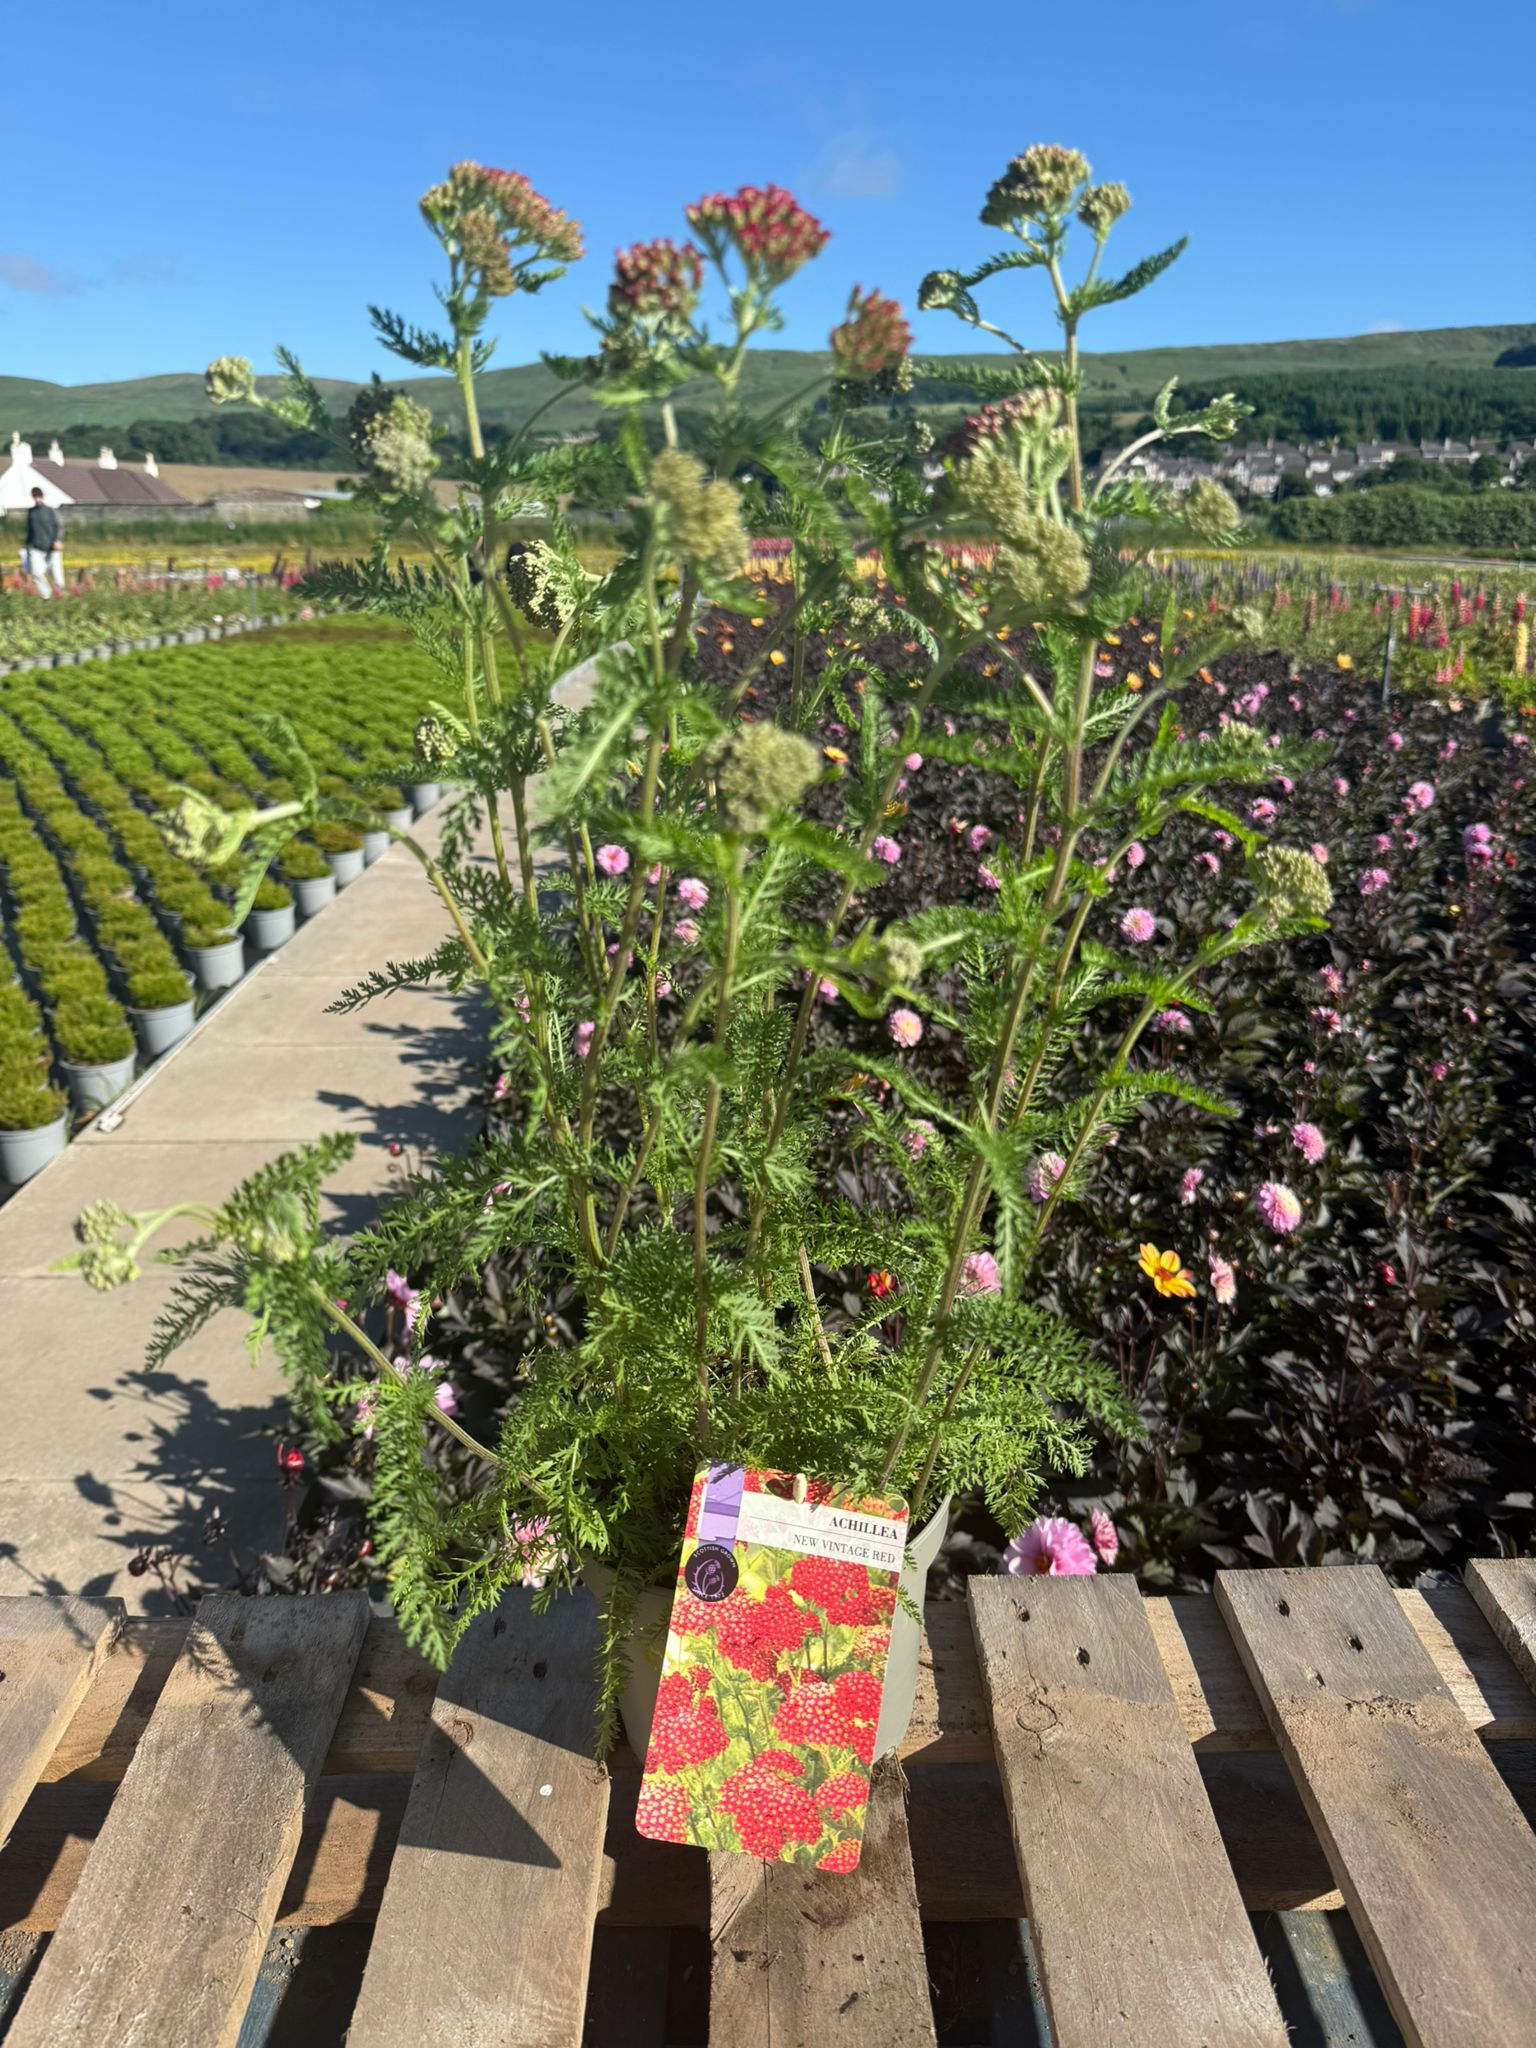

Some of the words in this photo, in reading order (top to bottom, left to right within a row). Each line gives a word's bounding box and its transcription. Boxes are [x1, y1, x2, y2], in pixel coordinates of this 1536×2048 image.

[829, 1516, 898, 1540] ACHILLEA
[693, 1546, 720, 1558] SCOTTISH
[720, 1548, 736, 1568] GROWN
[793, 1534, 819, 1547] NEW
[822, 1540, 870, 1558] VINTAGE
[872, 1550, 896, 1564] RED
